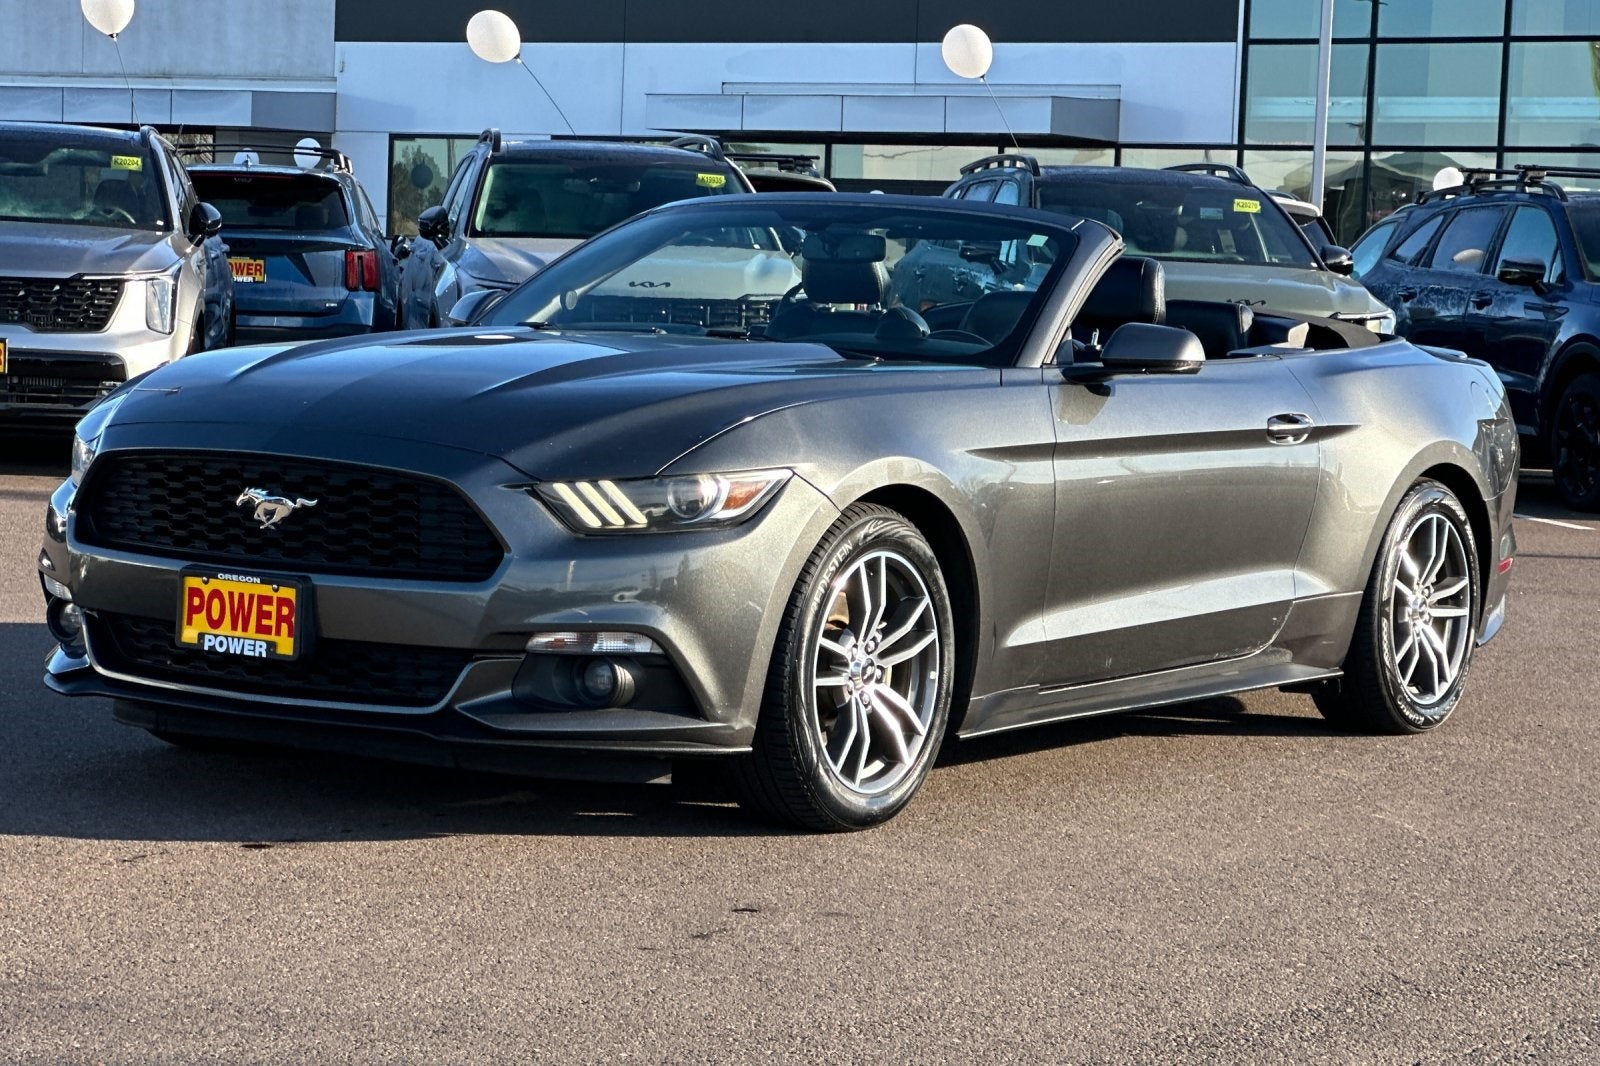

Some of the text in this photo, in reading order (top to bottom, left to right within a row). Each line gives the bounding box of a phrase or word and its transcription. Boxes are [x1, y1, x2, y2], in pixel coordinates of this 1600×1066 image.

[217, 573, 261, 584] OREGON
[186, 586, 295, 638] POWER
[203, 634, 267, 658] POWER
